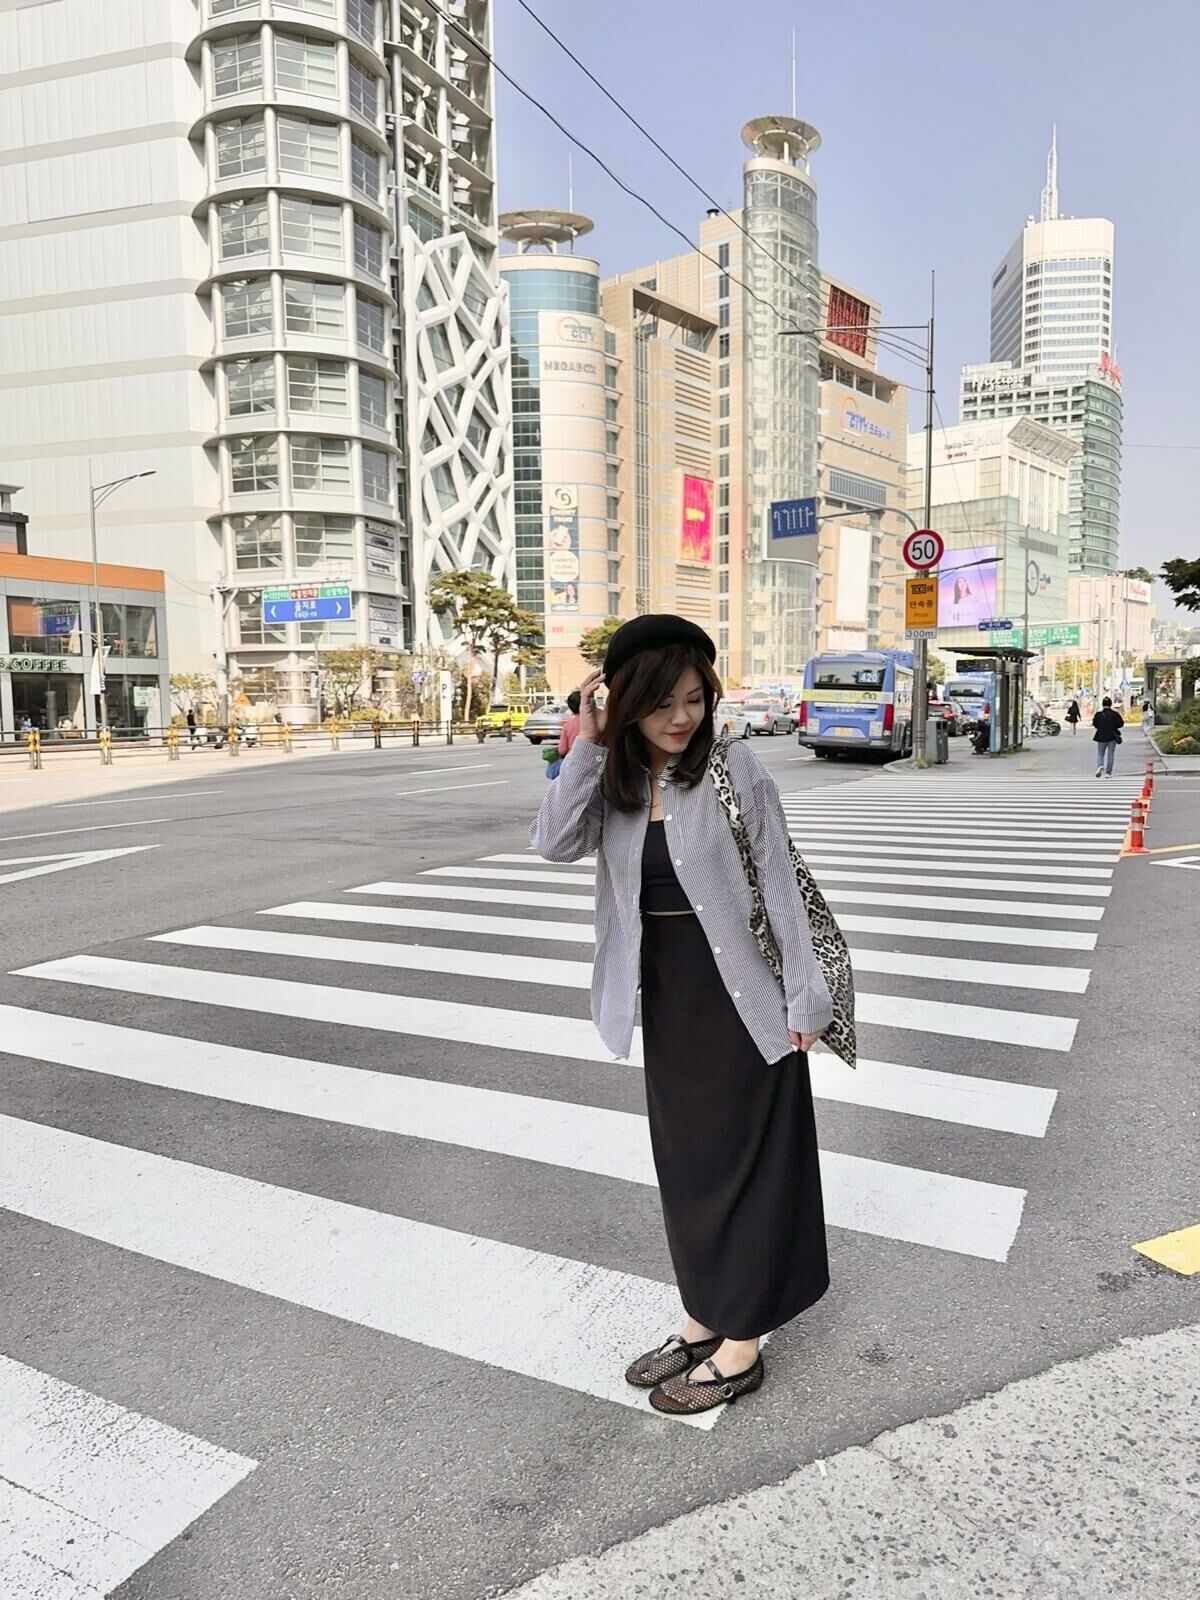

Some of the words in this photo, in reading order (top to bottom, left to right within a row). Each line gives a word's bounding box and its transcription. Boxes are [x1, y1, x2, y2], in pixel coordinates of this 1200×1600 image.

[544, 360, 596, 374] MEGABOX
[911, 539, 935, 560] 50
[909, 600, 934, 608] 단속중
[906, 630, 934, 638] 300m
[11, 657, 67, 672] COFFEE
[860, 673, 878, 683] 420
